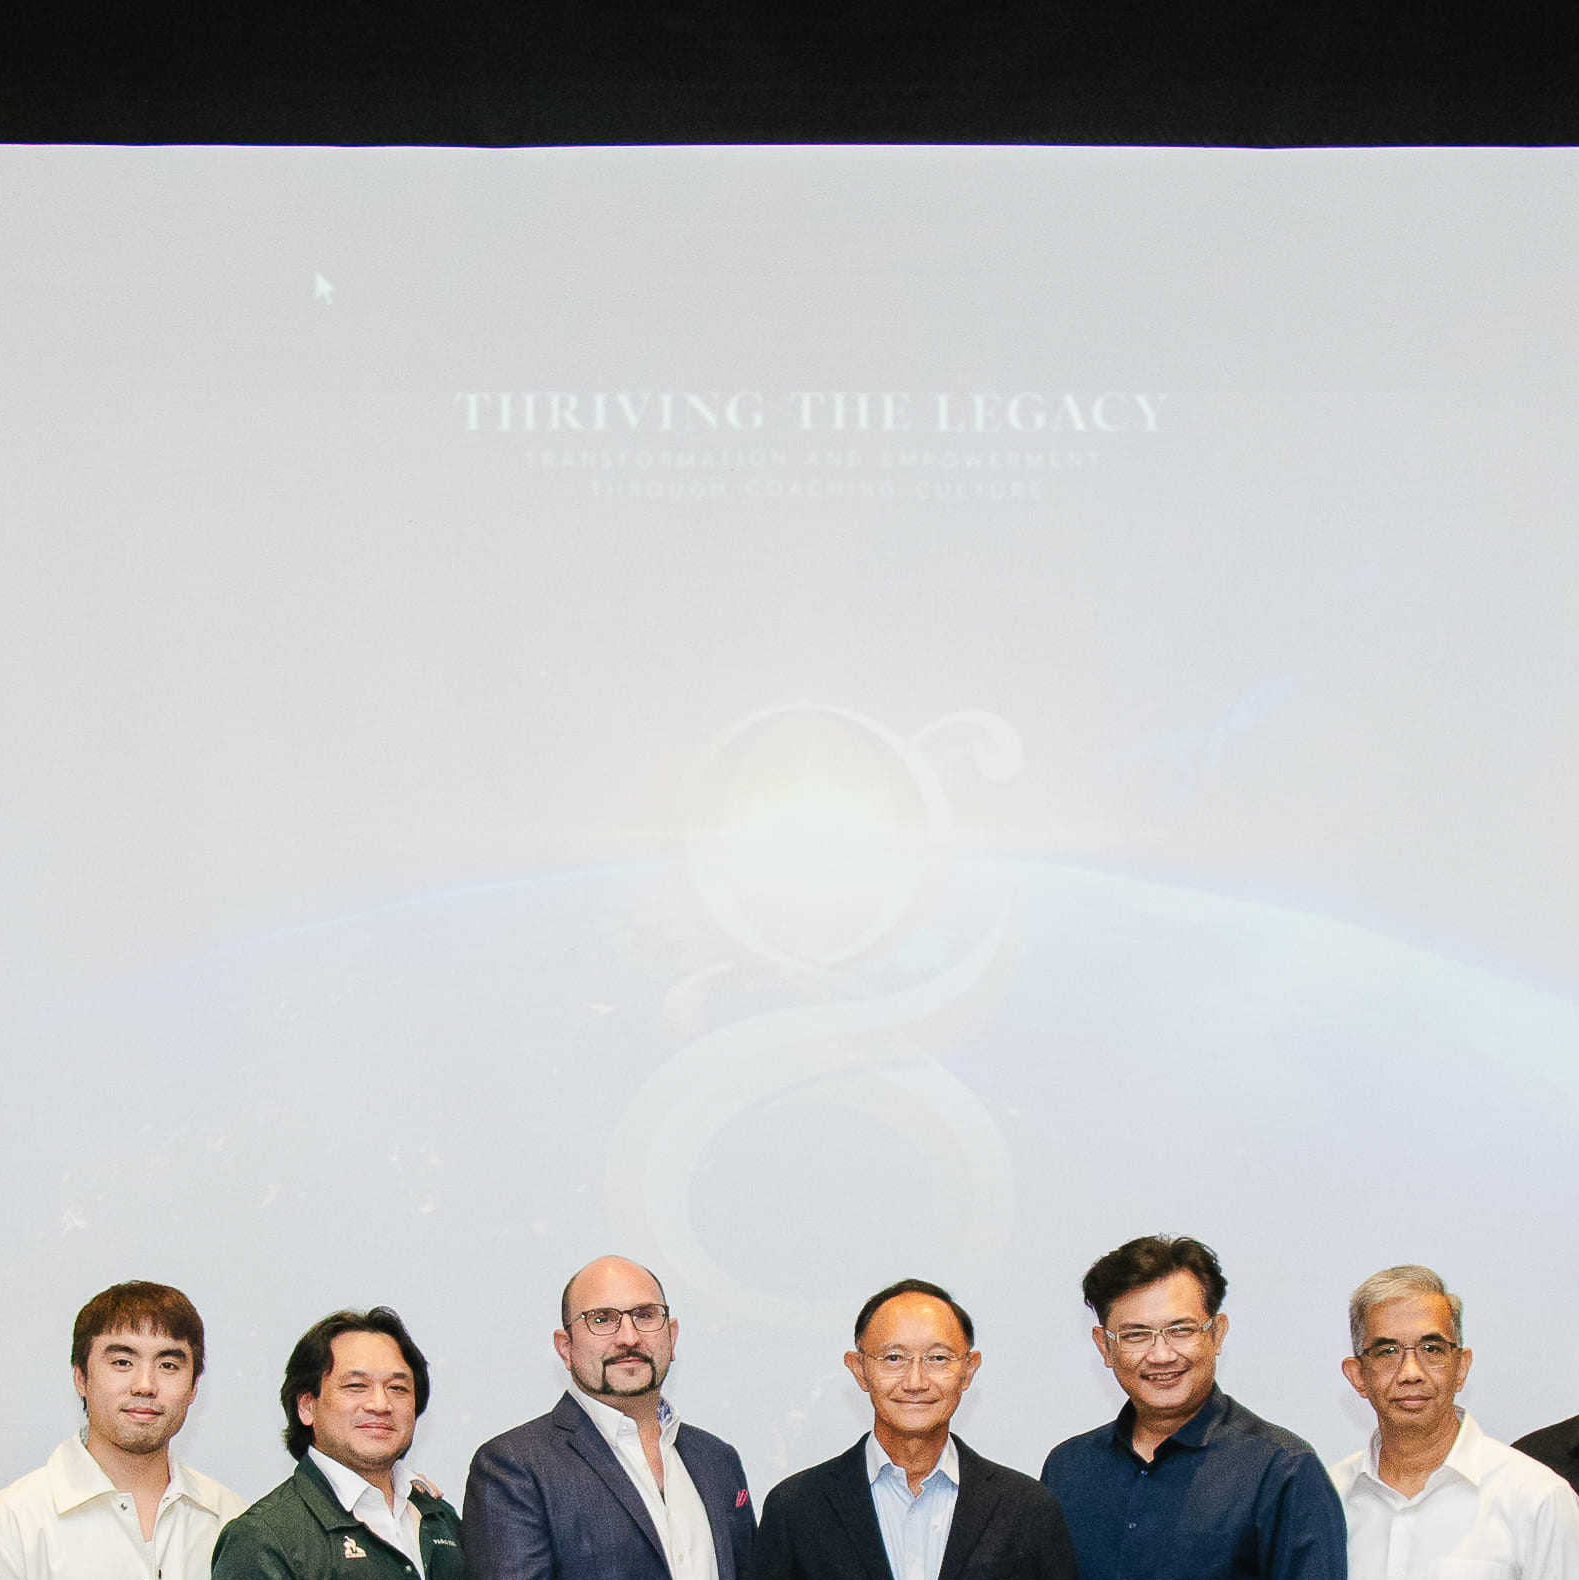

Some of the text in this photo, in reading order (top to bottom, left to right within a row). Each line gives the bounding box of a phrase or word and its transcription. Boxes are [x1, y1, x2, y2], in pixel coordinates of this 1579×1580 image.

[454, 391, 1170, 433] THRIVING THE LEGACY
[525, 450, 1102, 468] TRANSFORMATION AND EMPOWERMENT
[591, 479, 1044, 500] THROUGH COACHING CULTURE
